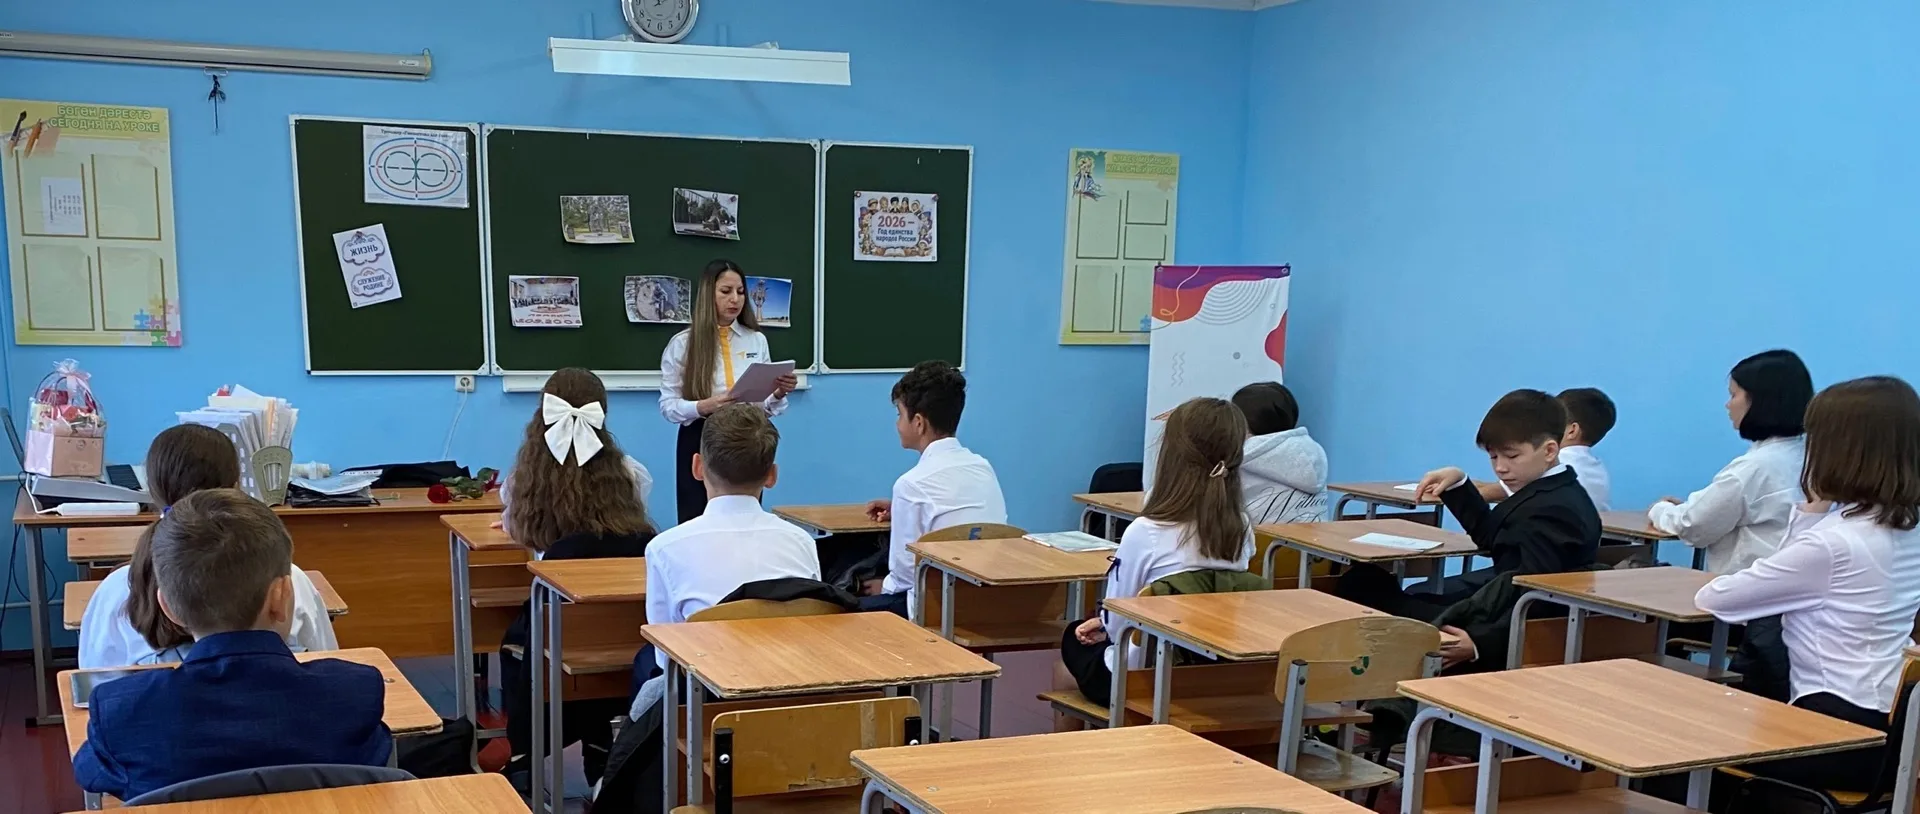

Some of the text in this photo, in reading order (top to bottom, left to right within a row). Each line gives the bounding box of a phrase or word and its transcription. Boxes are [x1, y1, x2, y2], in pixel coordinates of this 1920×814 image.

[639, 10, 644, 18] 8
[676, 12, 681, 21] 4
[647, 19, 651, 28] 7
[657, 22, 662, 31] 6
[668, 21, 673, 29] 5
[58, 105, 151, 120] БӨГӨН ДӘРЕСТӘ
[49, 117, 160, 132] СЕГОДНЯ НА УРОКЕ
[878, 216, 905, 227] 2026
[350, 244, 379, 257] ЖИЗНЬ
[357, 274, 385, 286] СЛУЖЕНИЕ
[363, 282, 384, 291] РОДИНЕ
